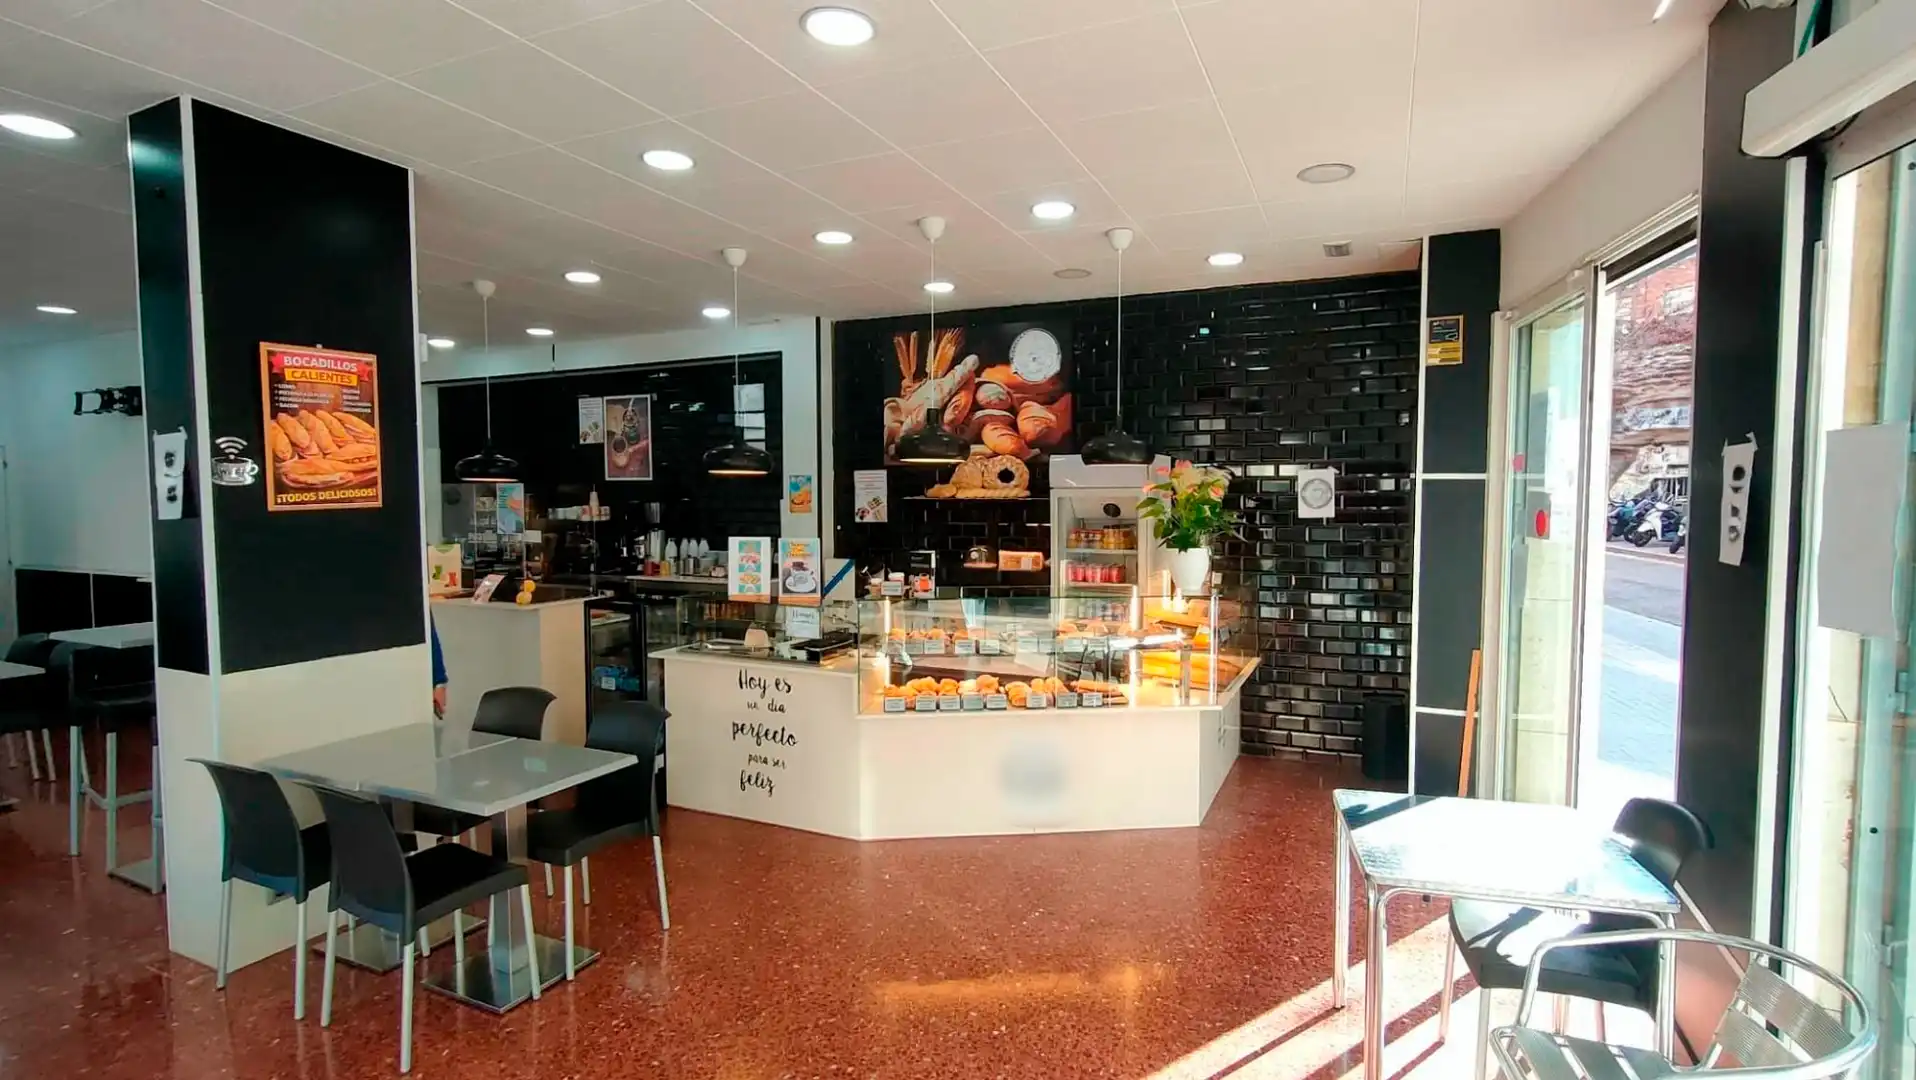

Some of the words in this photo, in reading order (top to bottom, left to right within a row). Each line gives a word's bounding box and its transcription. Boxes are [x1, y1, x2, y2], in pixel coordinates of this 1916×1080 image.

[283, 356, 357, 373] BOCADILLOS
[291, 370, 354, 384] CALIENTES
[276, 492, 317, 503] ¡TODOS
[318, 488, 377, 500] DELICIOSOS!
[738, 669, 767, 699] Hoy
[775, 677, 792, 694] es
[732, 721, 799, 747] perfecto
[748, 753, 769, 766] para
[772, 758, 787, 770] ser
[740, 769, 776, 798] feliz
